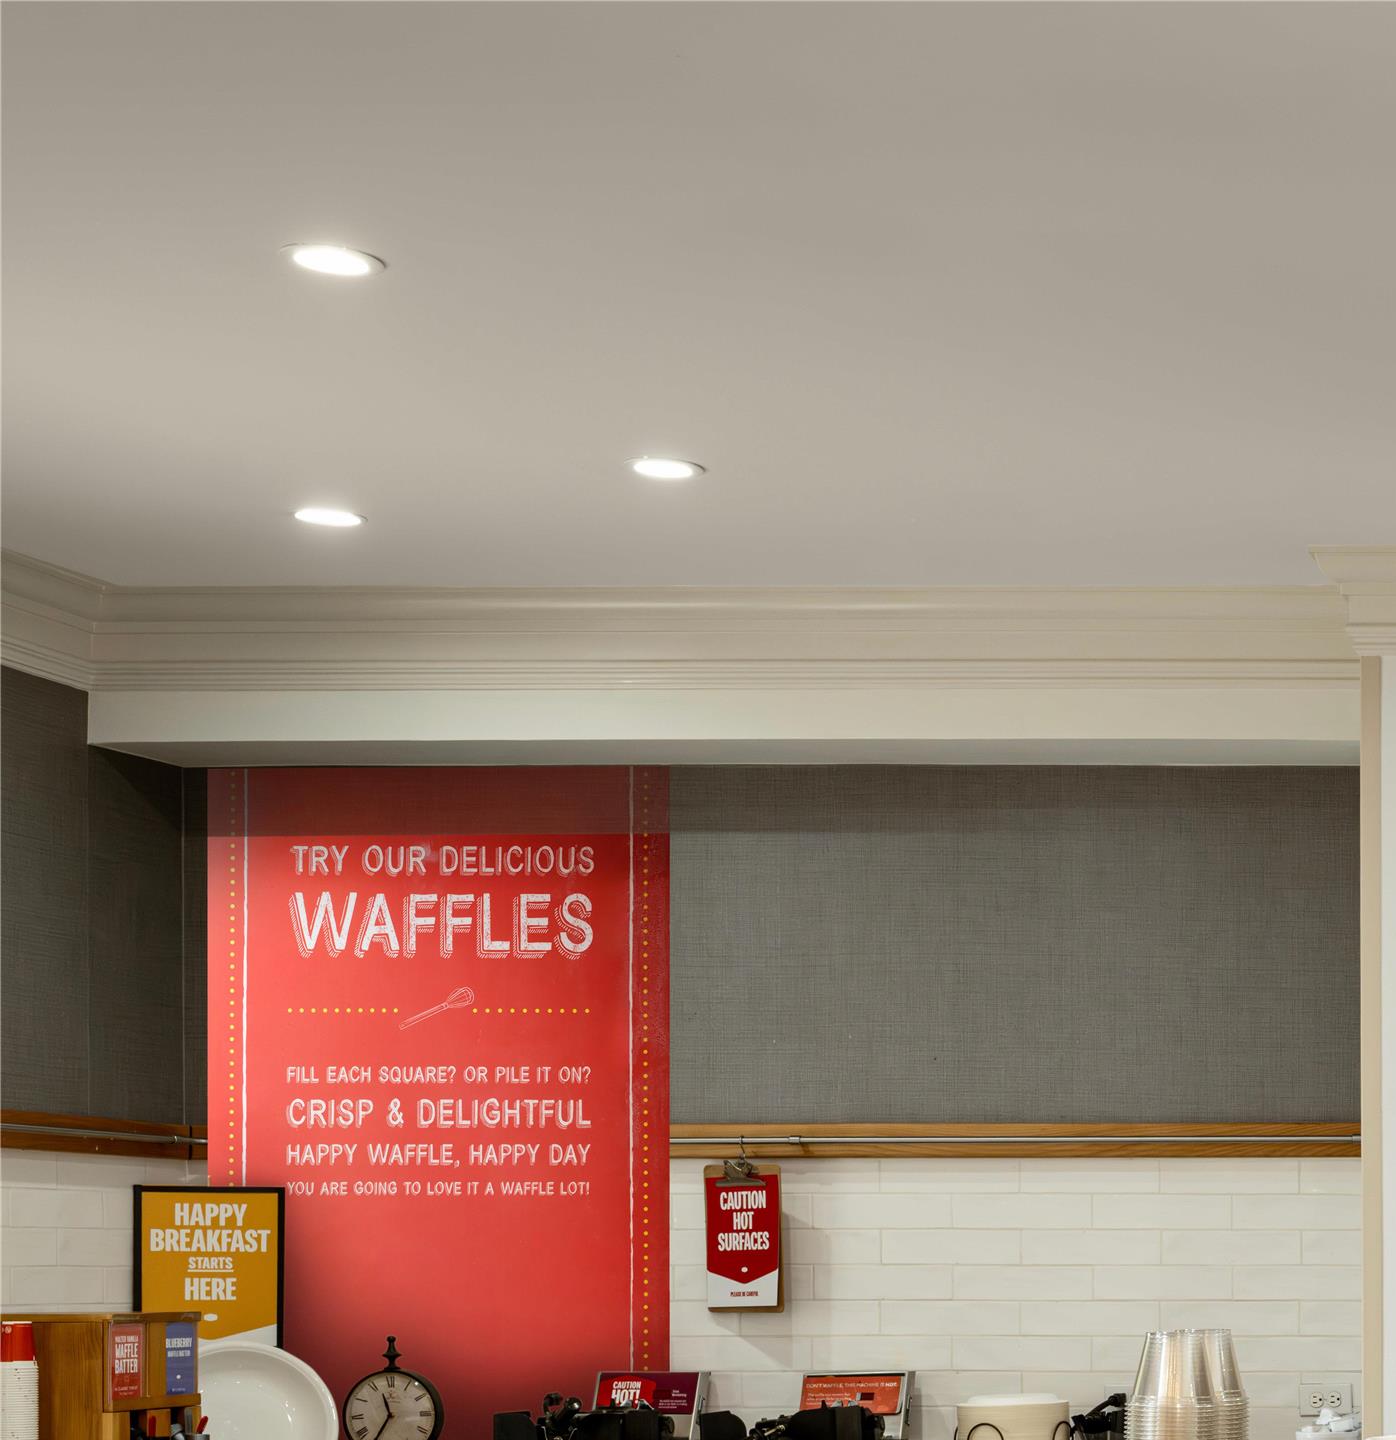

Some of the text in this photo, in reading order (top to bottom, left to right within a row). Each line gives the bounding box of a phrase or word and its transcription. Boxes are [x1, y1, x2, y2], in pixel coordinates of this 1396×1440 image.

[290, 845, 595, 876] TRY OUR DELICIOUS
[288, 892, 594, 960] WAFFLES
[287, 1066, 591, 1083] FILL EACH SQUARE? OR PILE IT ON?
[287, 1098, 592, 1129] CRISP & DELIGHTFUL
[286, 1143, 591, 1168] HAPPY WAFFLE, HAPPY DAY
[287, 1181, 590, 1196] YOU ARE GOING TO LOVE IT A WAFFLE LOT!
[719, 1190, 767, 1210] CAUTION
[174, 1202, 248, 1226] HAPPY
[732, 1211, 754, 1230] HOT
[149, 1228, 271, 1252] BREAKFAST
[717, 1231, 770, 1251] SURFACES
[187, 1256, 234, 1272] STARTS
[184, 1277, 237, 1300] HERE
[115, 1343, 139, 1358] WAFFLE
[165, 1338, 192, 1349] BLUEBERRY
[114, 1359, 138, 1374] BATTER
[612, 1381, 642, 1389] CAUTION
[611, 1389, 640, 1404] HOT!
